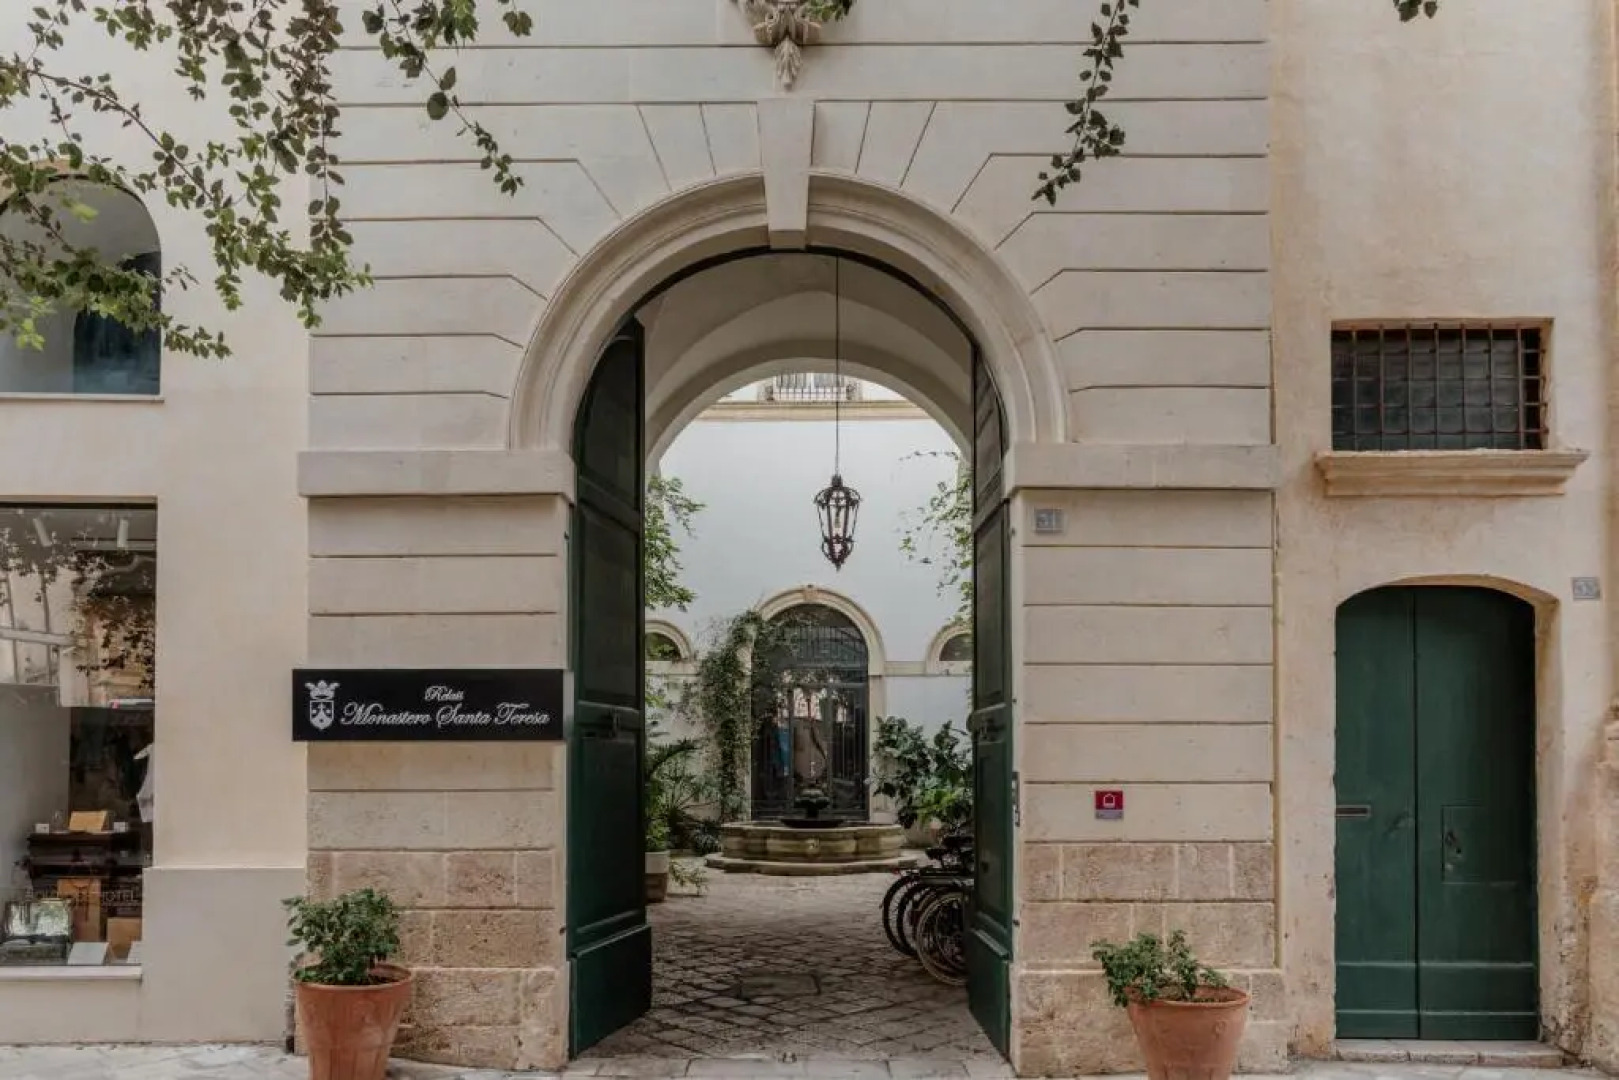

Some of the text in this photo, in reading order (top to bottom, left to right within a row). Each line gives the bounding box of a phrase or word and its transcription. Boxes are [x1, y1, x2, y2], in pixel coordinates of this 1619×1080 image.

[340, 701, 550, 728] Monastero Santa Teresa
